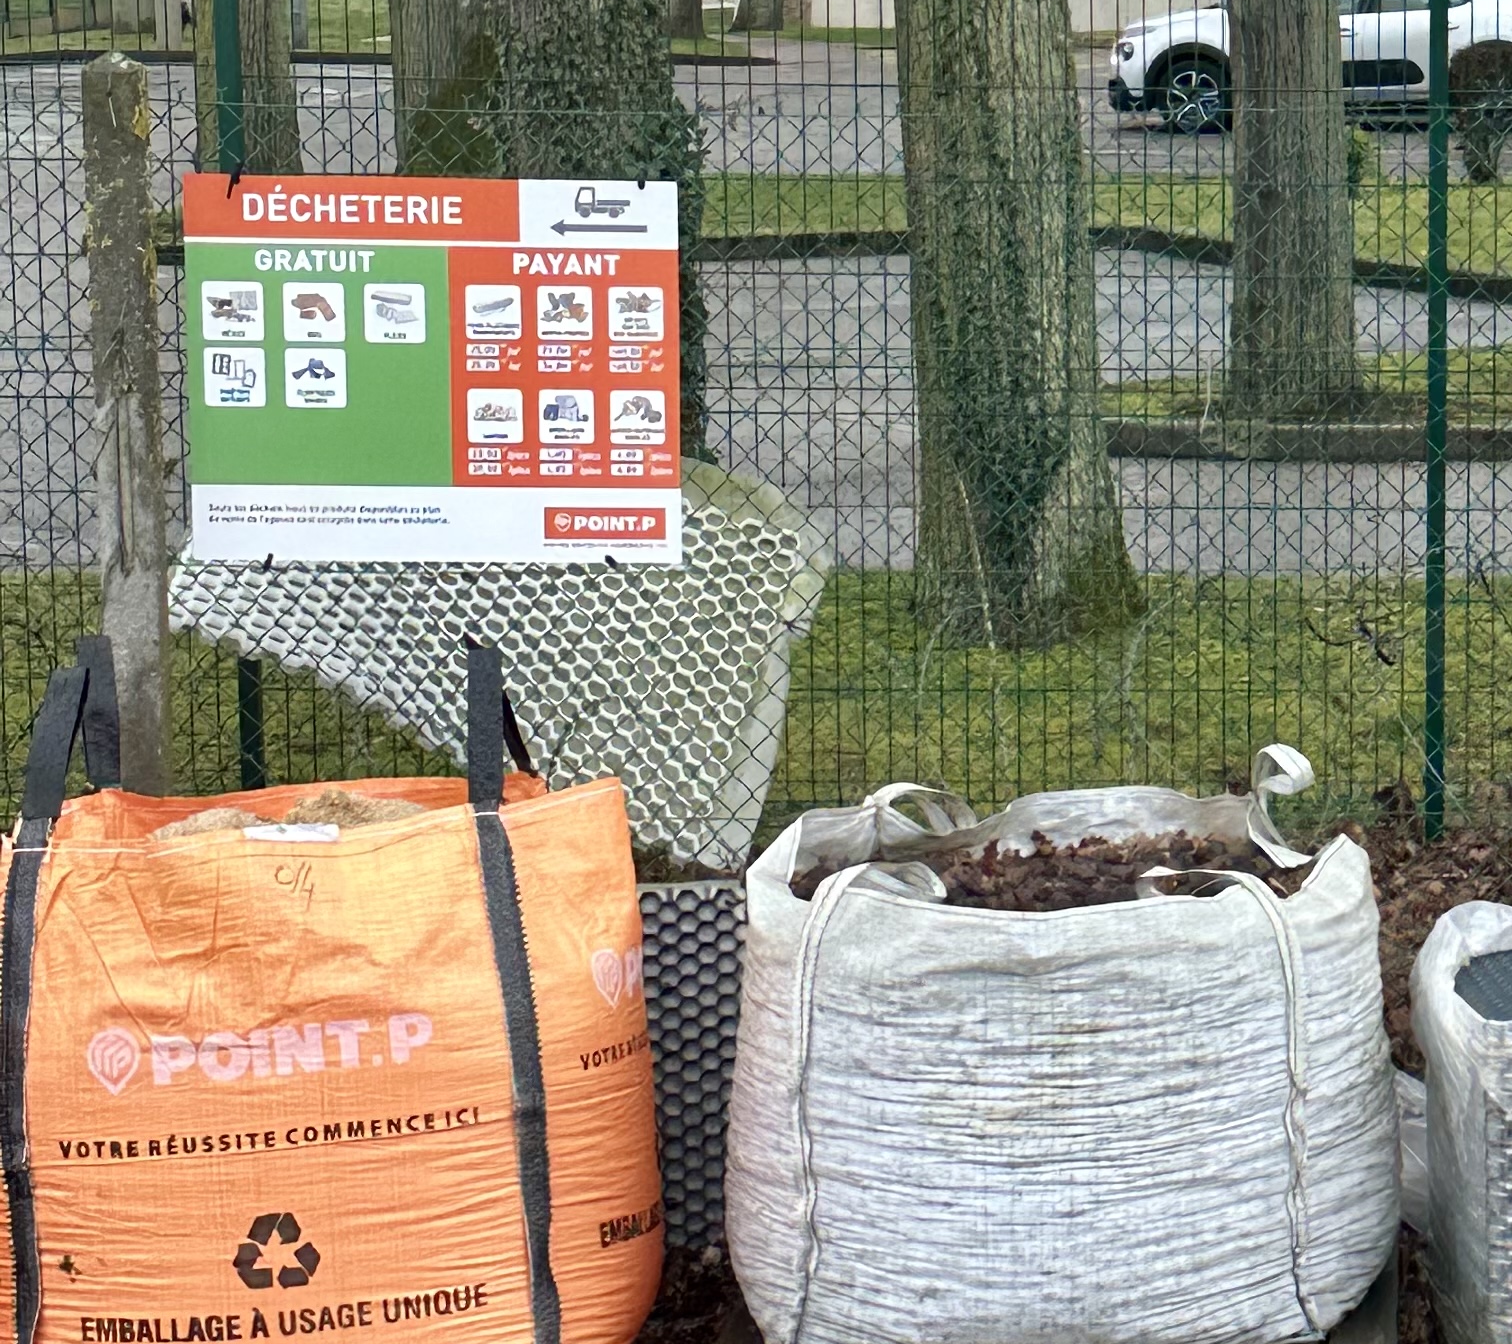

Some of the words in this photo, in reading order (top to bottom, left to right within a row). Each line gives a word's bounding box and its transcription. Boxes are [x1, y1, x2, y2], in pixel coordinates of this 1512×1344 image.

[243, 185, 462, 224] DÉCHETERIE
[255, 250, 374, 272] GRATUIT
[513, 253, 620, 275] PAYANT
[574, 516, 655, 531] POINT.P
[152, 1013, 433, 1085] POINT.P
[59, 1141, 138, 1159] VOTRE
[149, 1131, 275, 1156] RÉUSSITE
[286, 1114, 437, 1145] COMMENCE
[445, 1107, 480, 1128] ICI
[81, 1316, 242, 1342] EMBALLAGE
[251, 1308, 269, 1338] À
[279, 1302, 372, 1336] USAGE
[383, 1283, 490, 1323] UNIQUE
